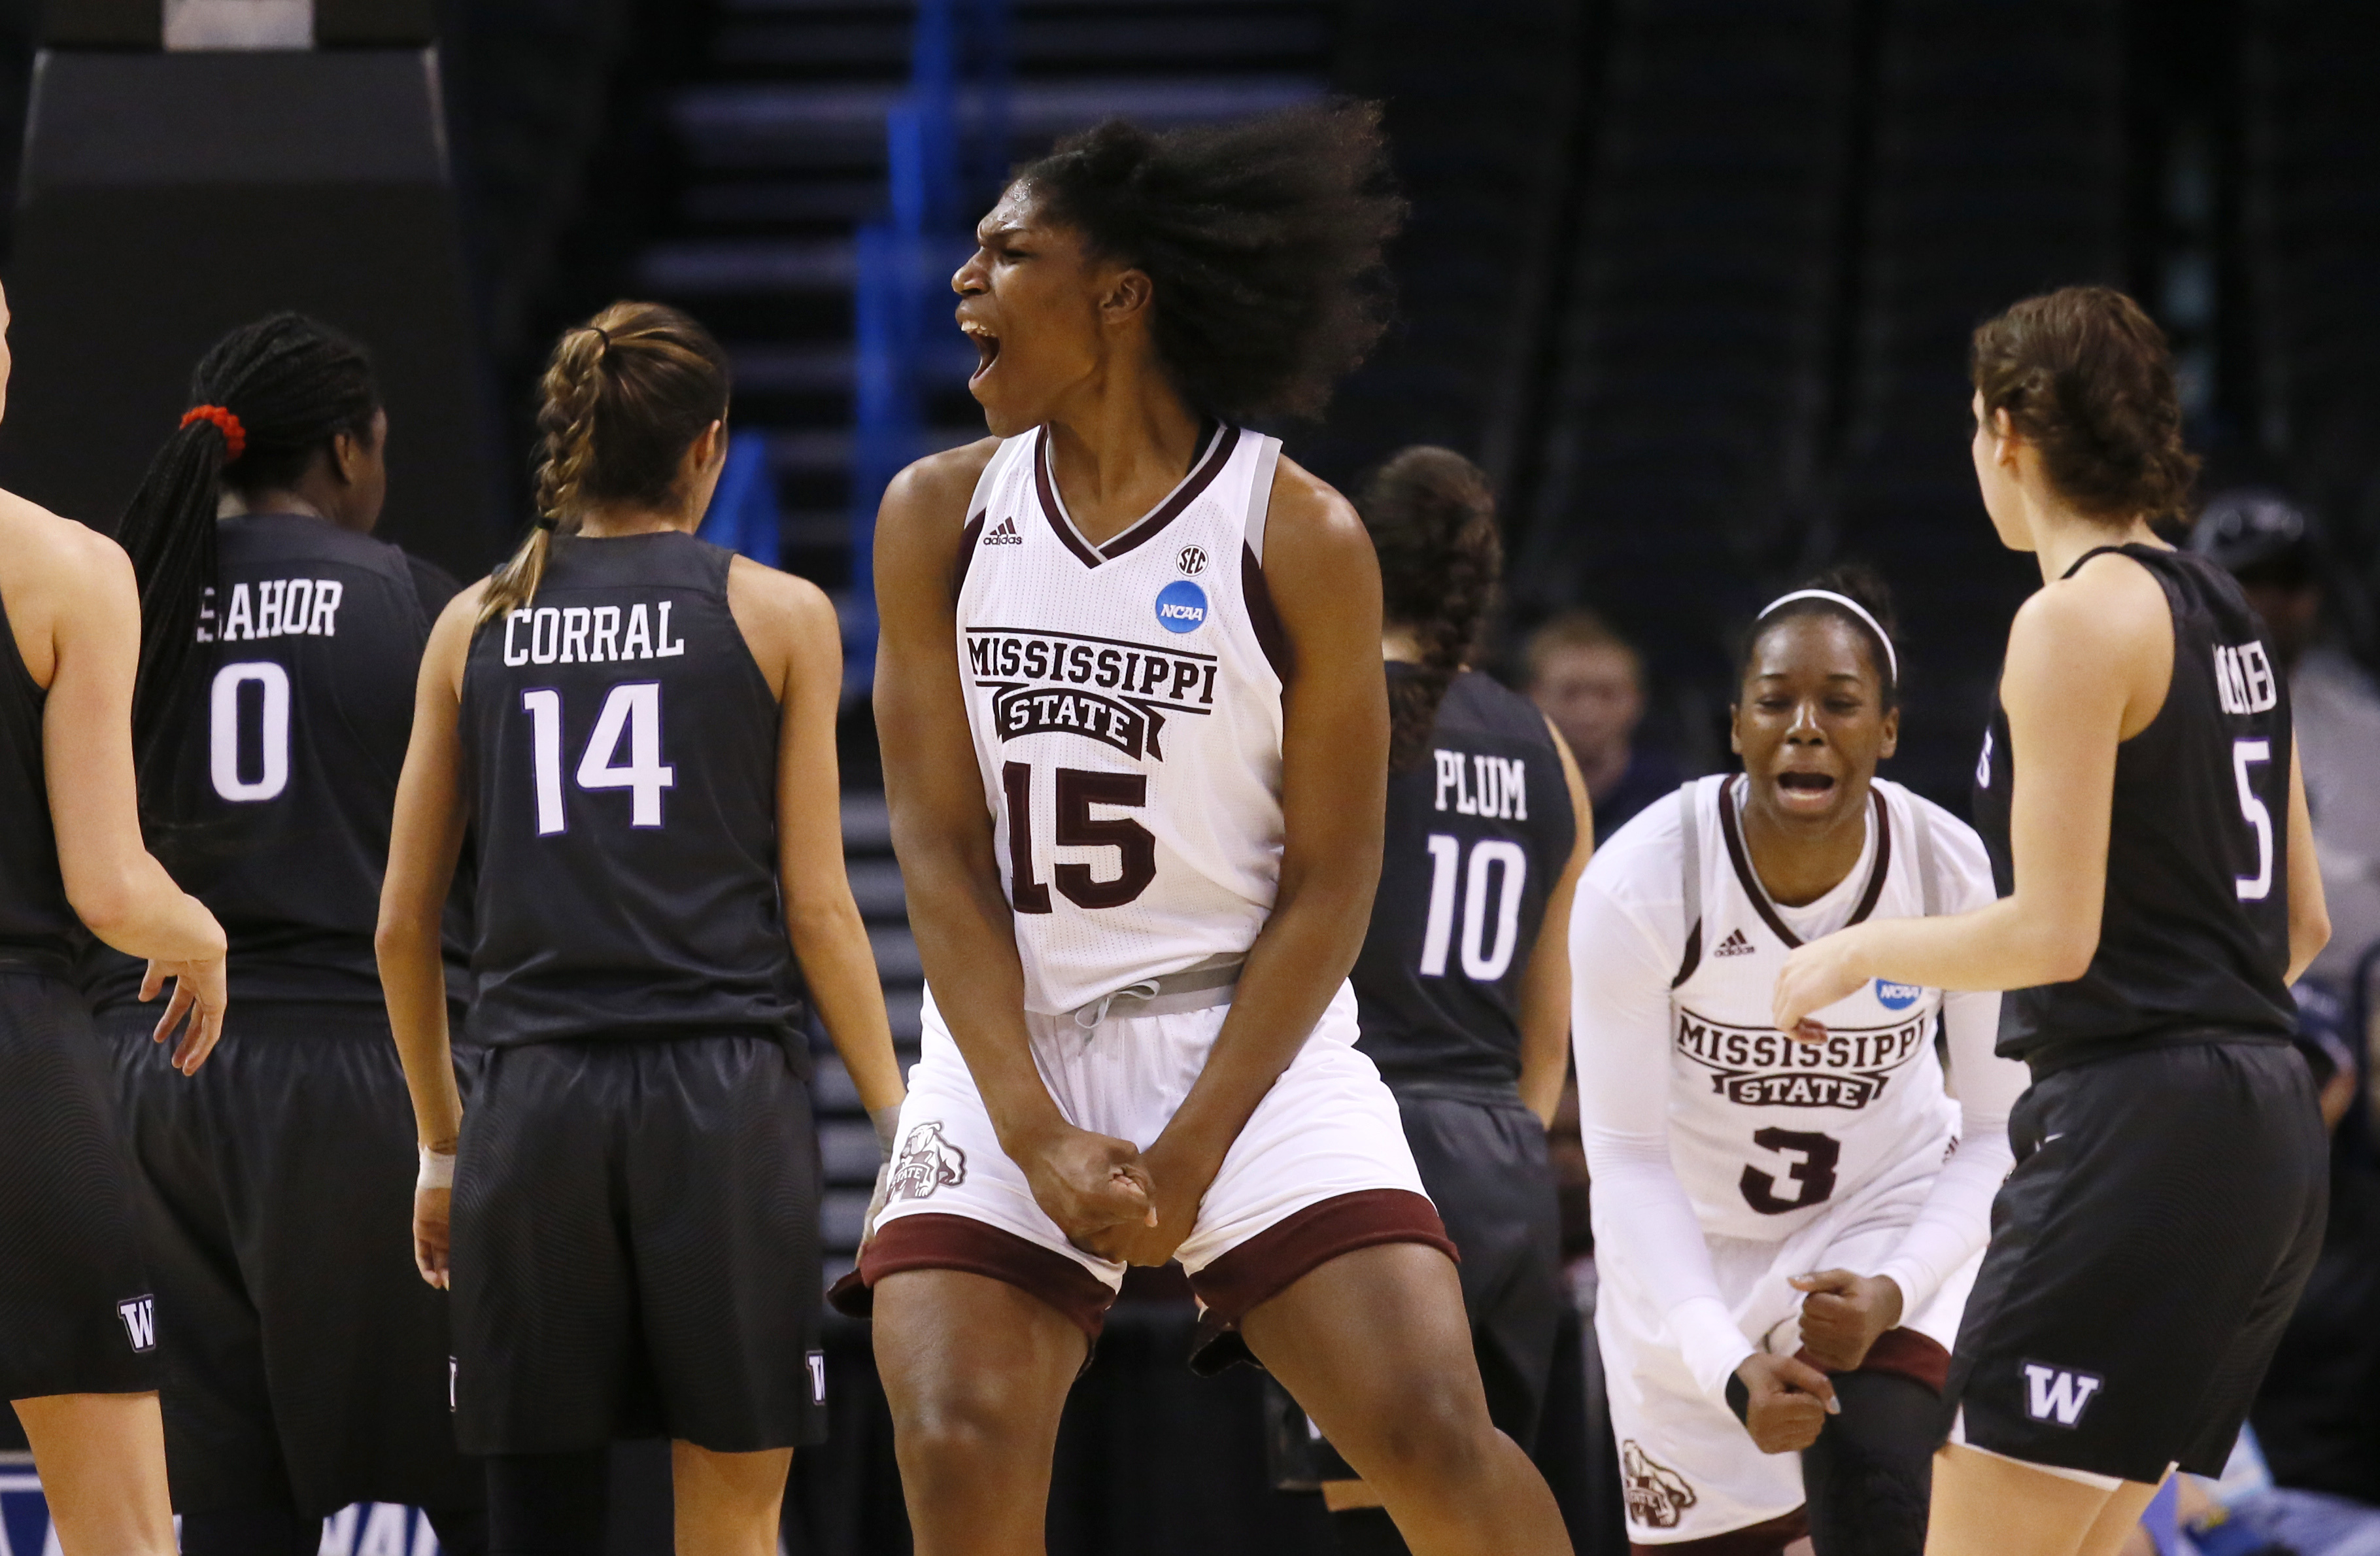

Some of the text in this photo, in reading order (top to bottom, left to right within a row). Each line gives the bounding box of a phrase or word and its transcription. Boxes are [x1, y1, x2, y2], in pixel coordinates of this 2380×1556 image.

[983, 534, 1022, 545] adidas
[1180, 550, 1206, 572] SEC
[503, 600, 685, 666] CORRAL
[1161, 604, 1204, 621] NCAA
[967, 637, 1217, 704] MISSISSIPPI
[210, 662, 290, 802] 0
[1009, 695, 1130, 746] STATE
[523, 682, 673, 835] 14
[1434, 748, 1528, 821] PLUM
[1002, 760, 1156, 914] 15
[2233, 740, 2273, 900] 5
[1420, 834, 1527, 981] 10
[1677, 1012, 1926, 1069] MISSISSIPPI
[1739, 1077, 1862, 1106] STATE
[1739, 1127, 1841, 1215] 3
[120, 1299, 154, 1349] W
[2024, 1364, 2100, 1426] W
